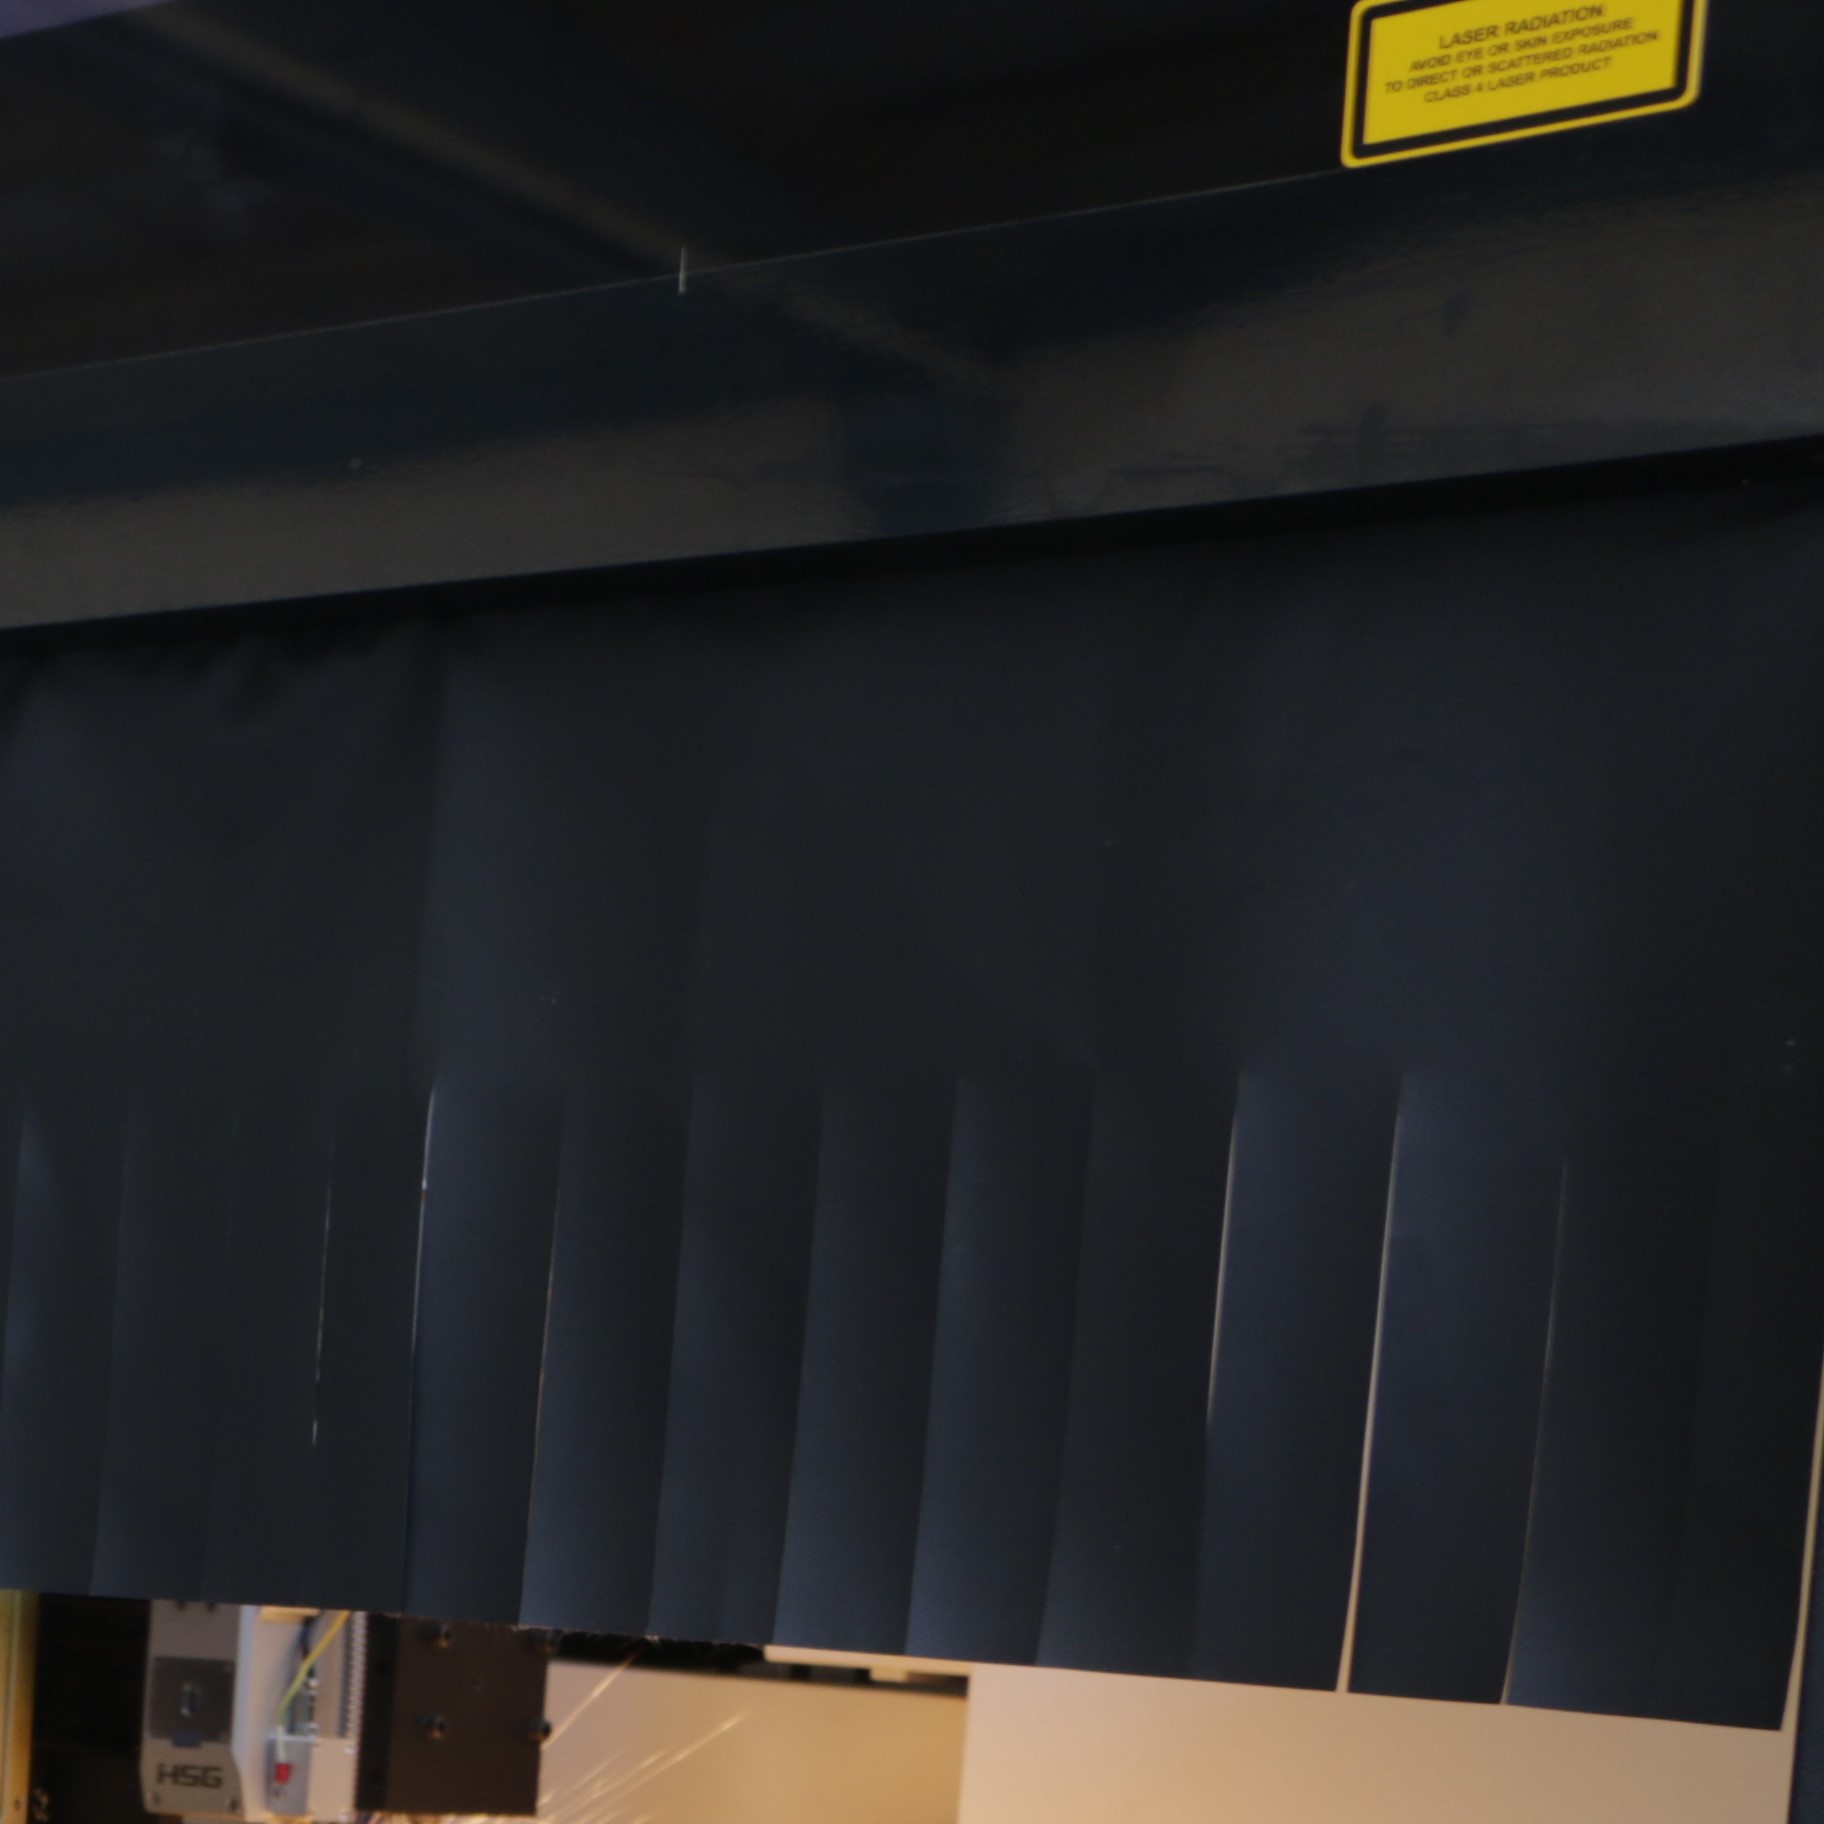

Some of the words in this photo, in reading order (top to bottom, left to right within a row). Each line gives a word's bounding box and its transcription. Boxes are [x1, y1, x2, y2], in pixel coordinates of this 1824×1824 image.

[1409, 54, 1451, 72] AVOID
[1455, 47, 1483, 62] EYE
[1488, 43, 1509, 57] OR
[1514, 36, 1547, 51] SKIN
[1552, 17, 1634, 44] EXPOSURE
[1439, 25, 1499, 49] LASER
[1504, 4, 1605, 34] RADIATION
[1384, 79, 1403, 93] TO
[1407, 69, 1457, 89] DIRECT
[1462, 65, 1483, 79] OR
[1487, 47, 1573, 73] SCATTERED
[1578, 30, 1659, 56] RADIATION
[1423, 84, 1471, 103] CLASS
[1474, 80, 1485, 93] 4
[1488, 72, 1537, 92] LASER
[1540, 56, 1612, 82] PRODUCT
[156, 1763, 224, 1790] HSG
